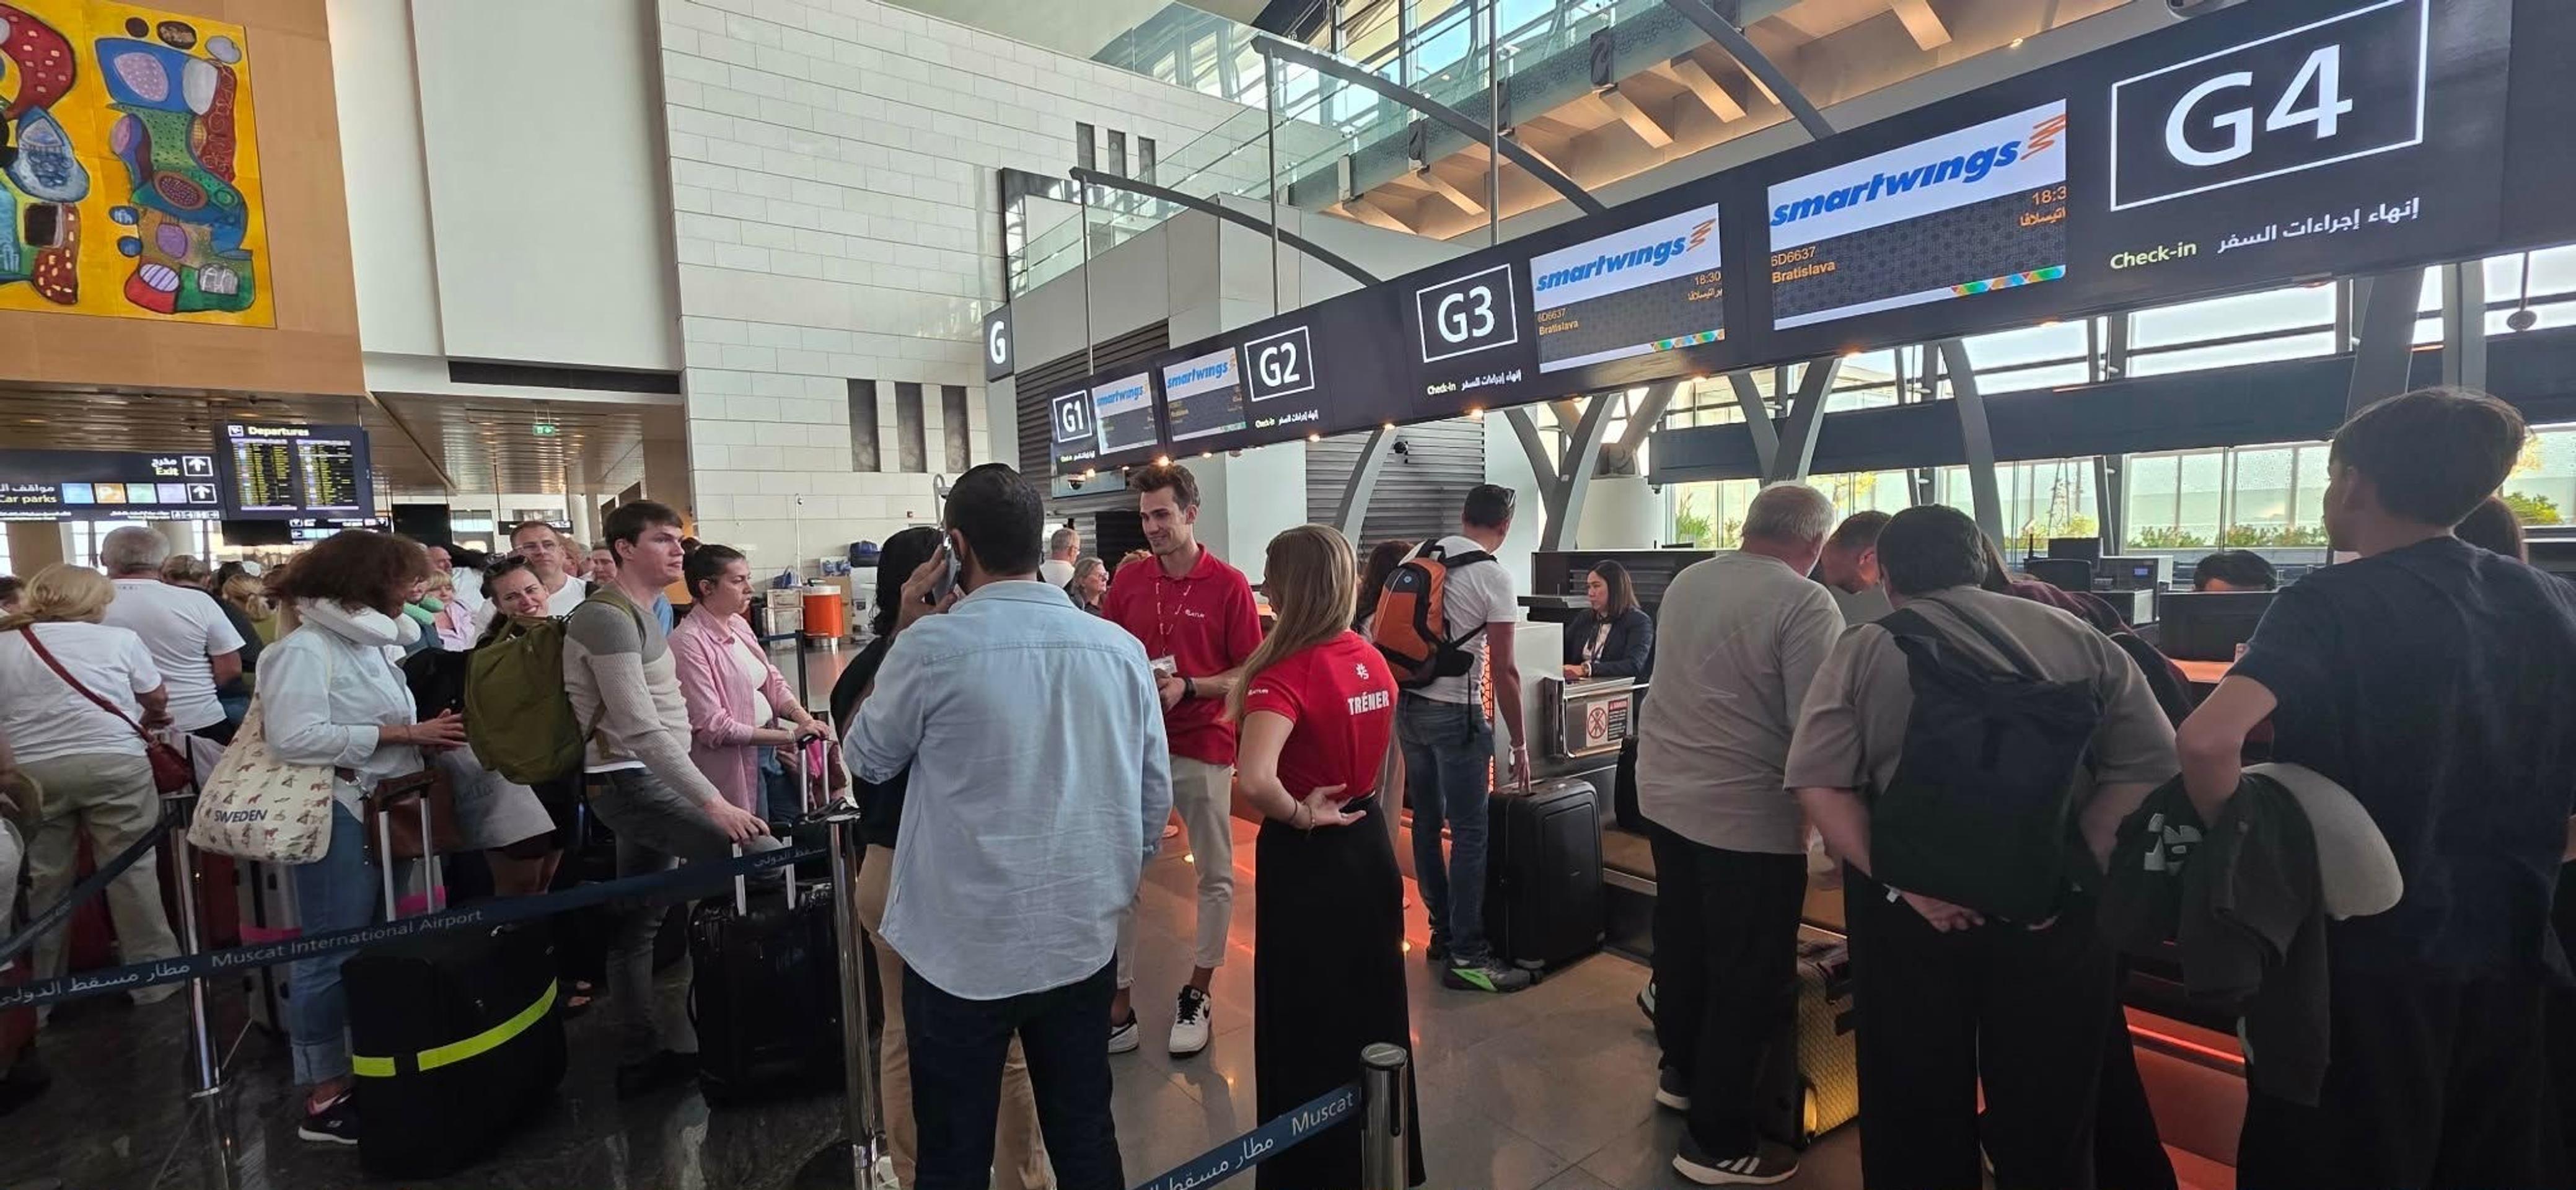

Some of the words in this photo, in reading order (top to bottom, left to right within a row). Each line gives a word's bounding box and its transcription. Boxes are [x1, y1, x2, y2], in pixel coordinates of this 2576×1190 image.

[2165, 44, 2353, 167] G4
[1770, 140, 2022, 227] smartwings
[2368, 197, 2420, 223] إنهاء
[2283, 209, 2360, 238] إجراءات
[2217, 224, 2277, 253] السفر
[1536, 236, 1686, 293] smartwings
[1771, 246, 1816, 267] 6D6637
[2110, 242, 2197, 270] Check-in
[1695, 271, 1721, 285] 18:30
[1772, 261, 1836, 284] Bratislava
[1437, 285, 1495, 344] G3
[1539, 320, 1579, 335] Bratislava
[990, 321, 1006, 364] G
[1167, 363, 1228, 389] smartwings
[1260, 342, 1300, 388] G2
[1427, 382, 1456, 395] Check-in
[1062, 400, 1084, 433] G1
[248, 426, 310, 437] Departures
[156, 467, 180, 476] Exit
[22, 494, 57, 504] parks
[1347, 690, 1389, 715] TRÉNER
[214, 809, 268, 823] SWEDEN
[213, 946, 284, 967] Muscat
[291, 927, 414, 954] International
[418, 910, 483, 931] Airport
[69, 974, 138, 992] مسقط
[146, 962, 191, 982] مطار
[1292, 1091, 1354, 1136] Muscat
[1236, 1137, 1274, 1170] مطار
